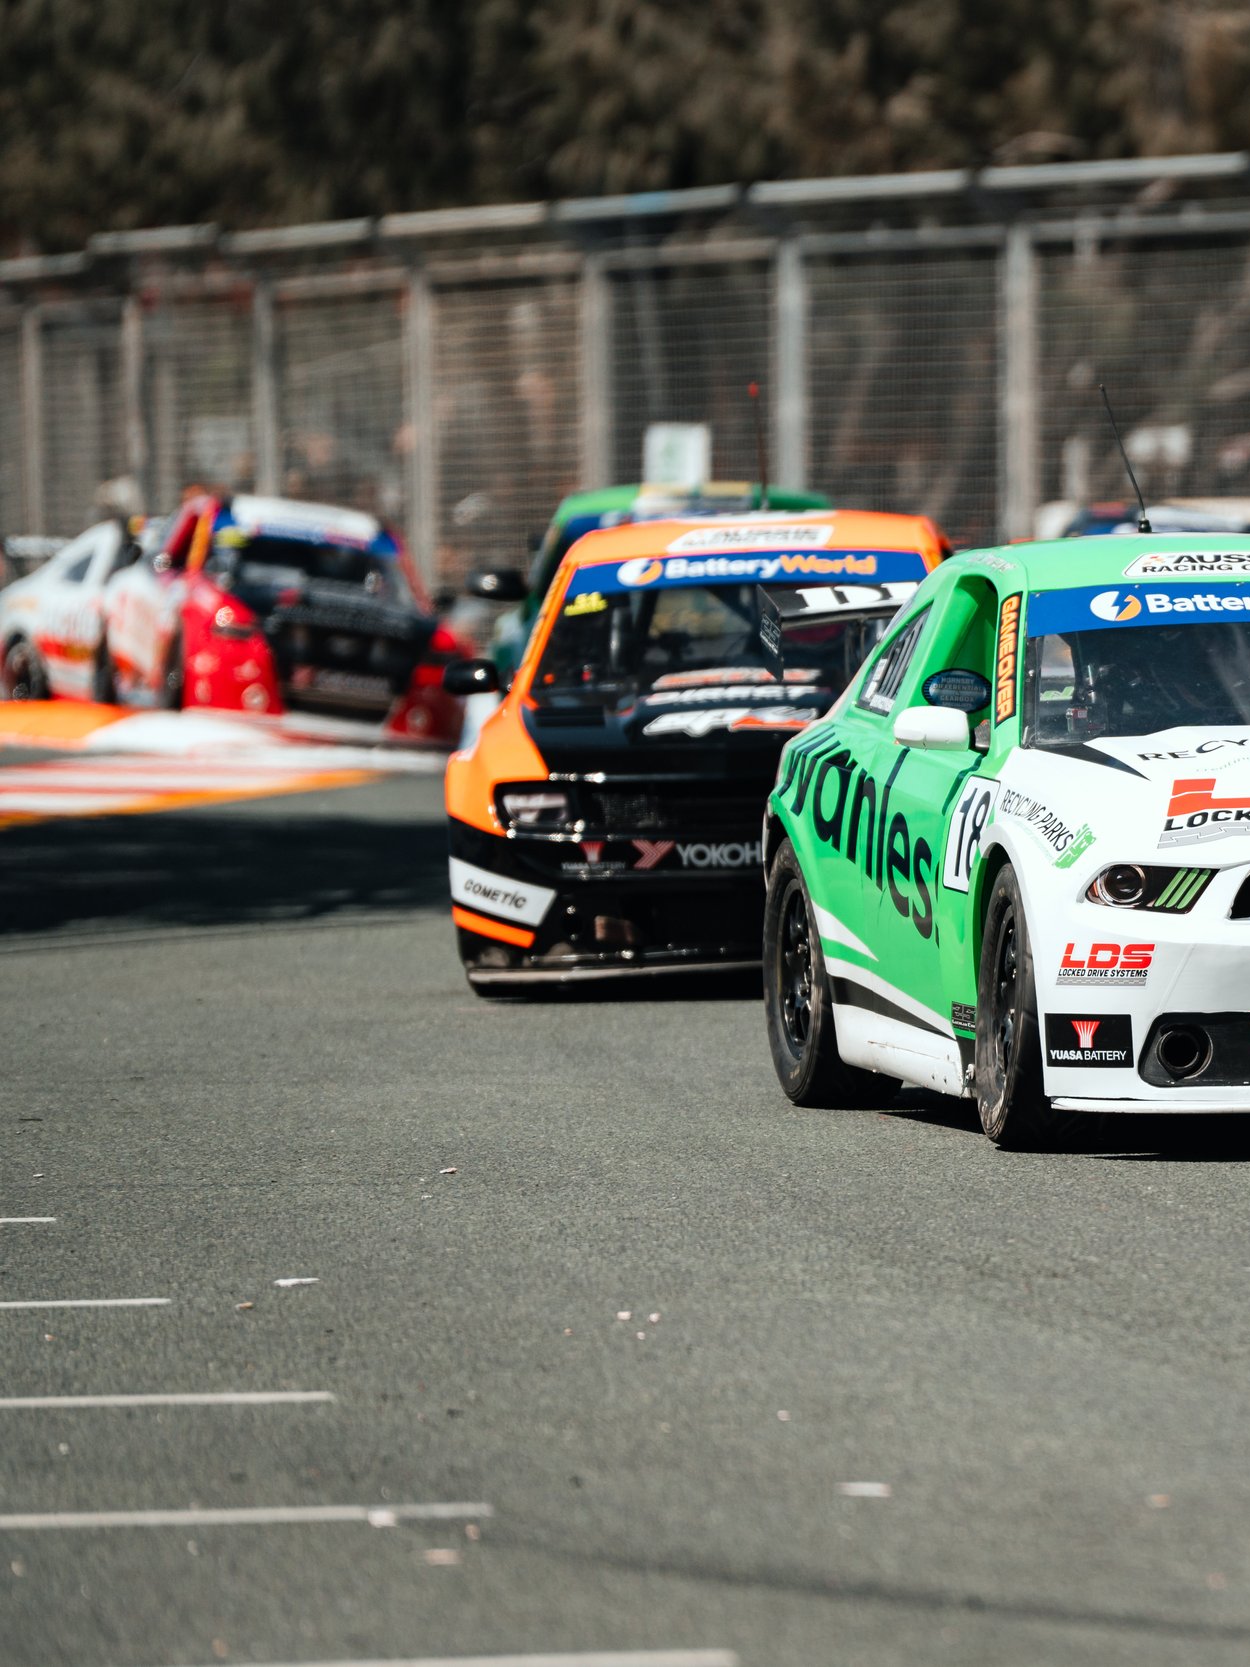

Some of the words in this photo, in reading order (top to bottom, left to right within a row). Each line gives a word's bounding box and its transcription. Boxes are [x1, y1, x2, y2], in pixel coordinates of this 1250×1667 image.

[1141, 564, 1233, 573] RACING
[1000, 789, 1047, 821] RECYCLING
[1033, 811, 1074, 852] PARKS
[954, 787, 991, 883] 18
[1061, 943, 1155, 969] LDS
[1058, 969, 1086, 977] LOCKED
[1087, 969, 1108, 977] DRIVE
[1110, 969, 1149, 978] SYSTEMS
[1050, 1049, 1083, 1061] YUASA
[1084, 1050, 1127, 1061] BATTERY
